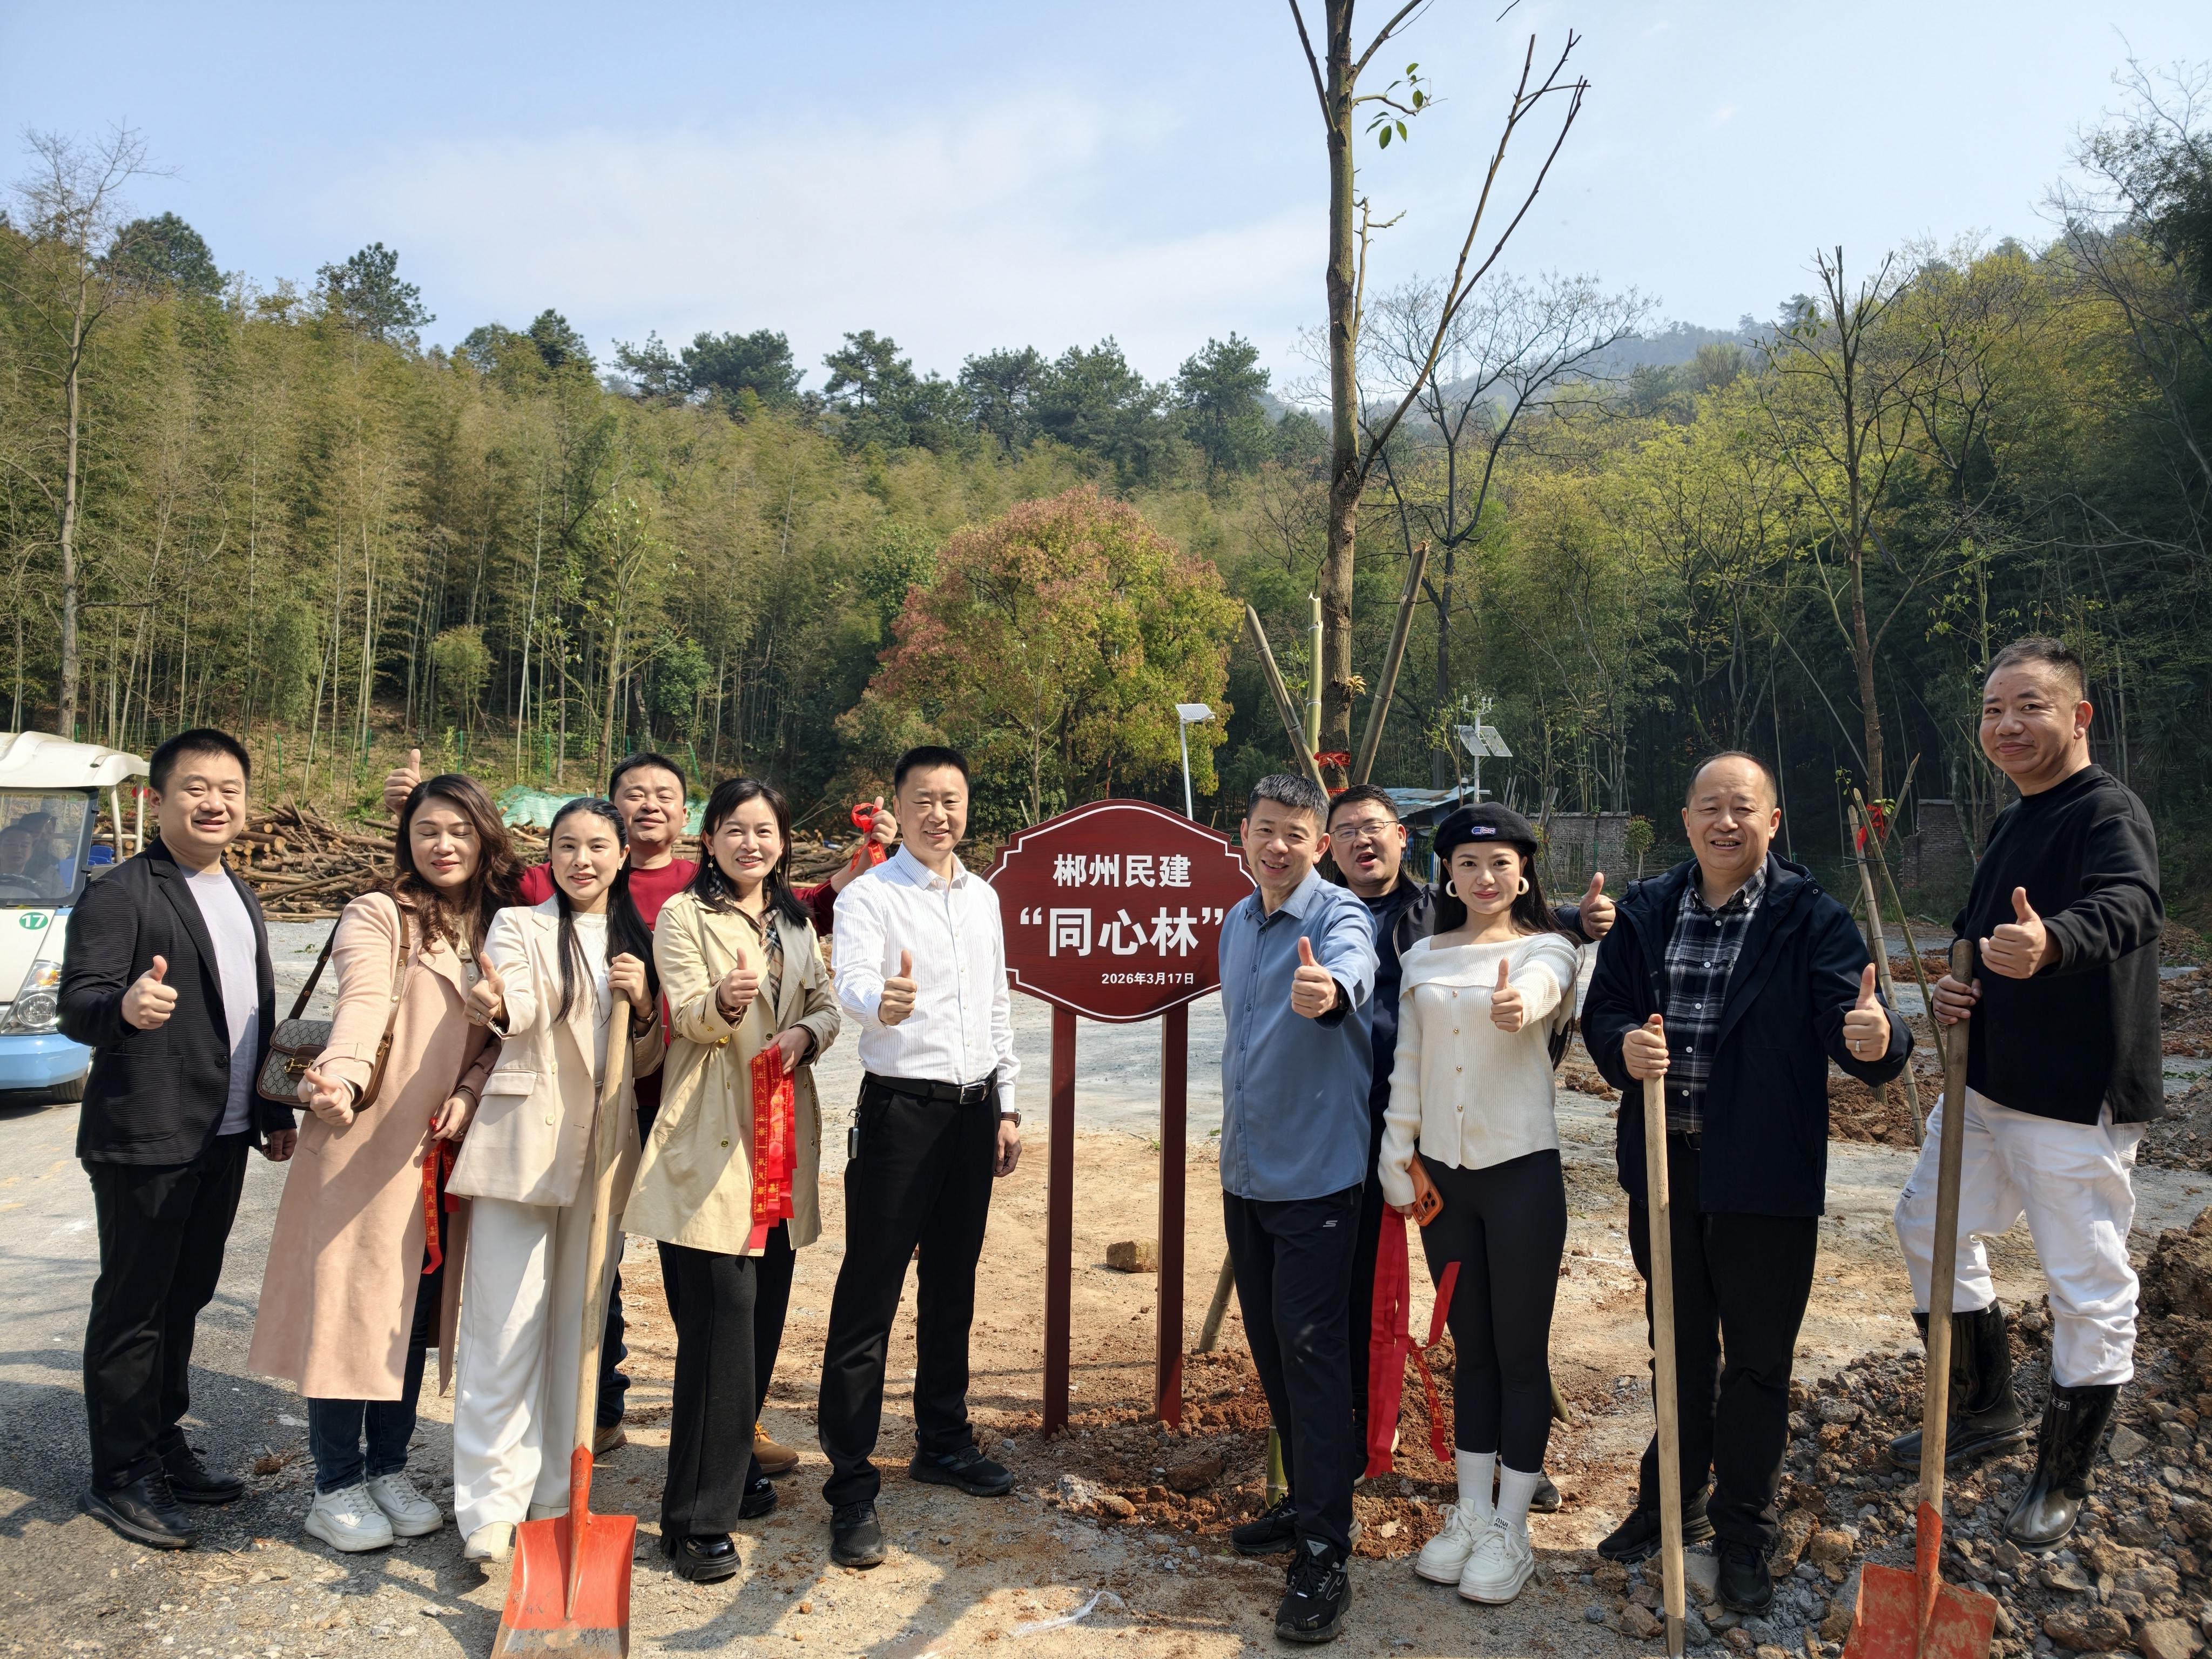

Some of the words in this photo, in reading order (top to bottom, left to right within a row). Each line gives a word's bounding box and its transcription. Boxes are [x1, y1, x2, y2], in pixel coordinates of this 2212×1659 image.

[1053, 854, 1192, 887] 郴州民建
[22, 915, 45, 927] 17
[1020, 907, 1224, 957] “同心林”
[1101, 972, 1194, 985] 2026年3月17日
